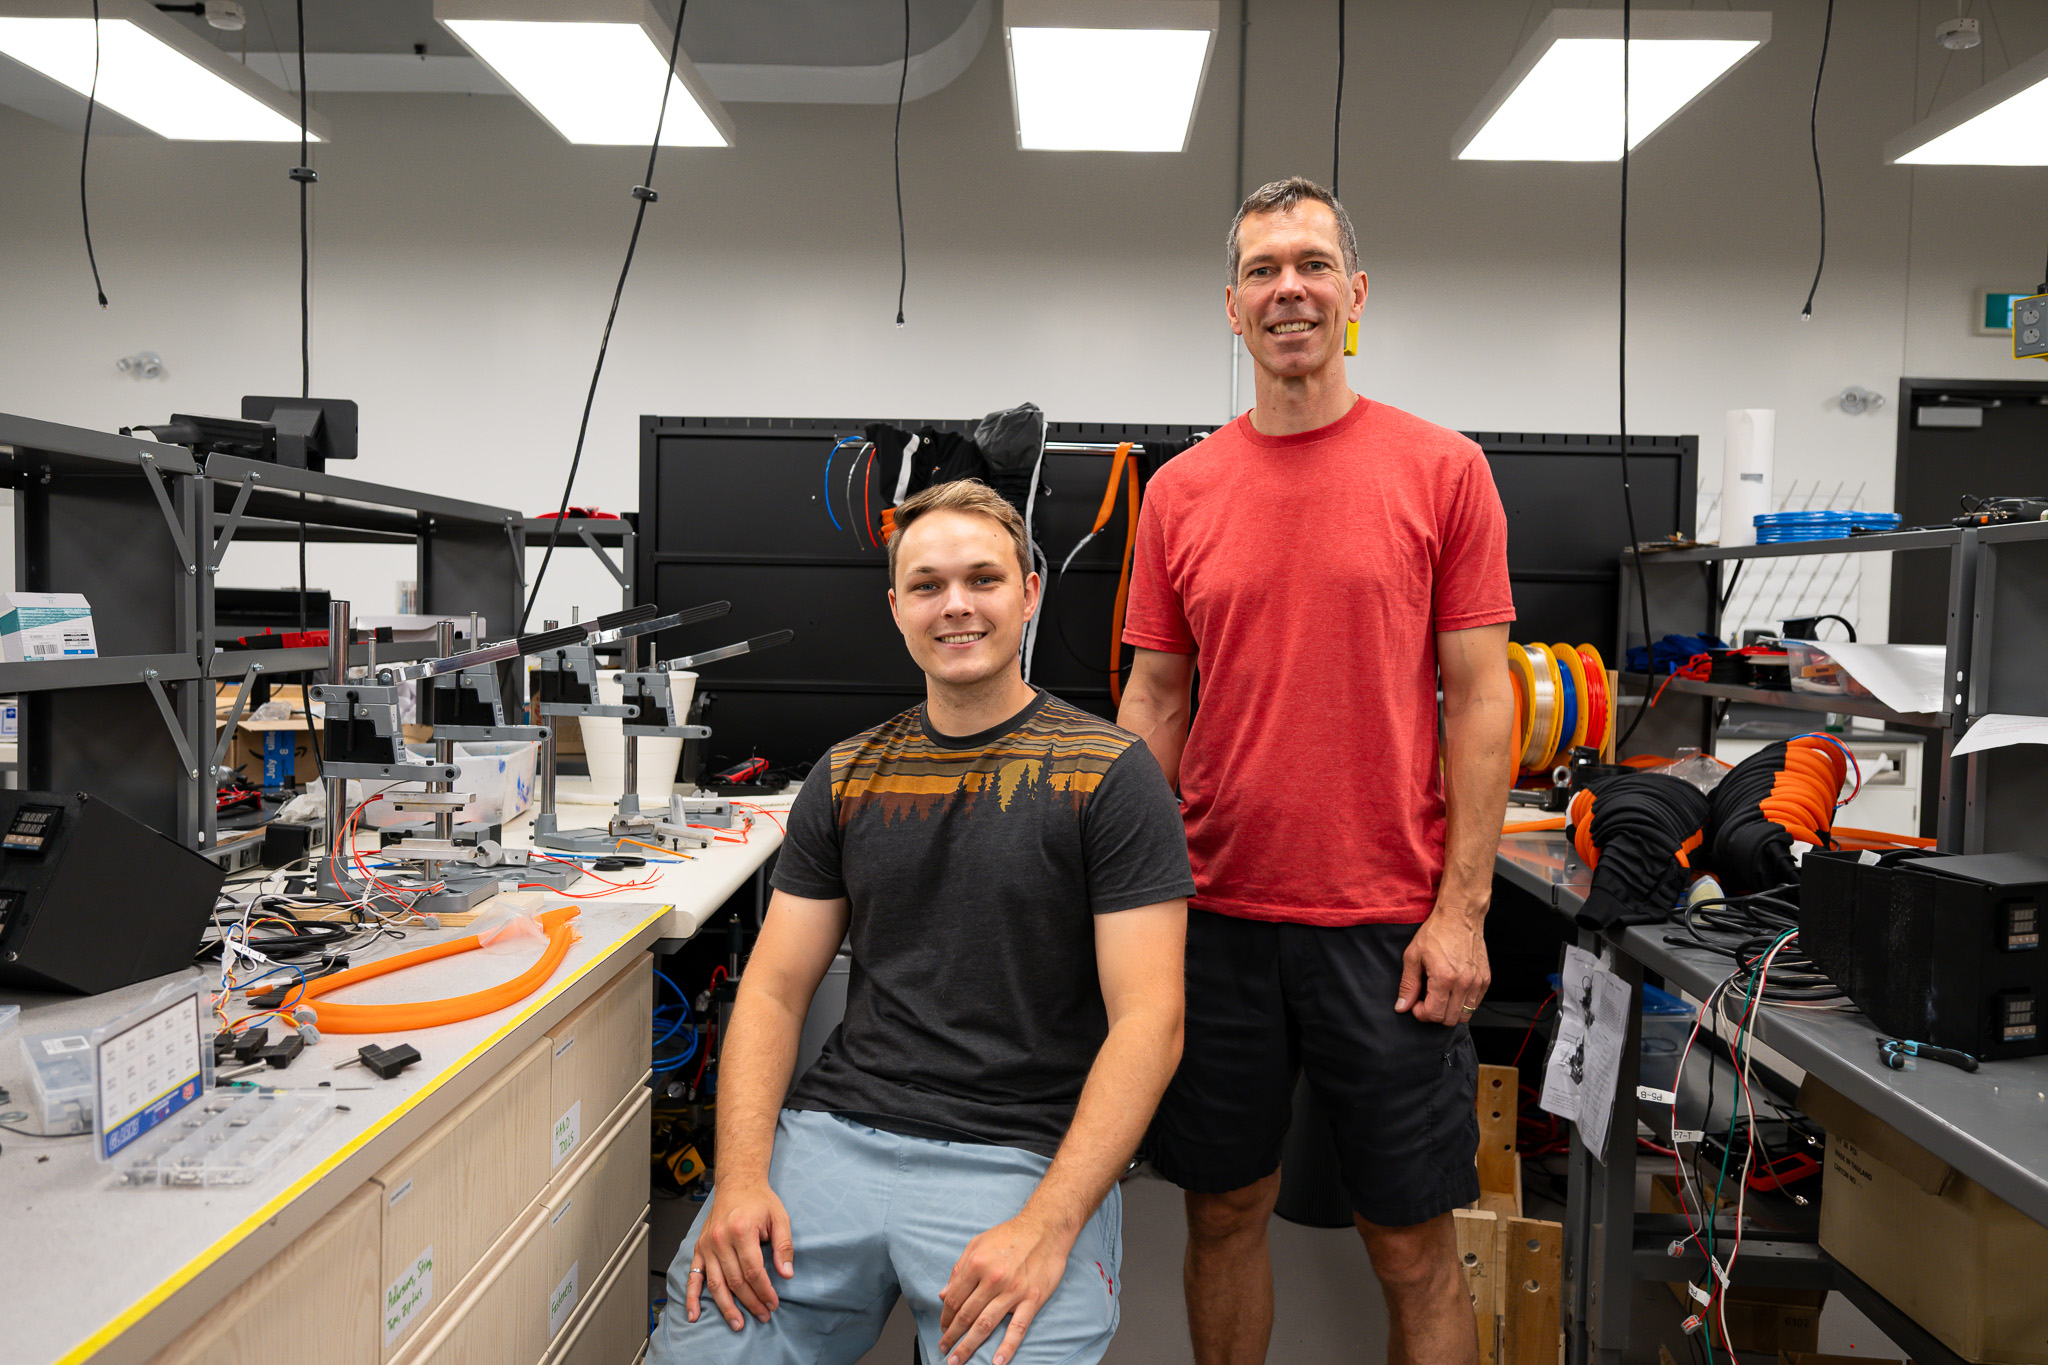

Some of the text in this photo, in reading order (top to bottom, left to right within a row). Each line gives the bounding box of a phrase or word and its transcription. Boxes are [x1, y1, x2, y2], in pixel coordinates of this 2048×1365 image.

[265, 758, 278, 779] July
[1640, 1091, 1663, 1101] P5-B
[555, 1116, 571, 1141] HAND
[1673, 1130, 1693, 1140] P7-T
[558, 1130, 574, 1156] TOOLS
[1833, 1162, 1849, 1179] CARTON
[1834, 1148, 1846, 1162] MADE
[1851, 1161, 1873, 1181] THAILAND
